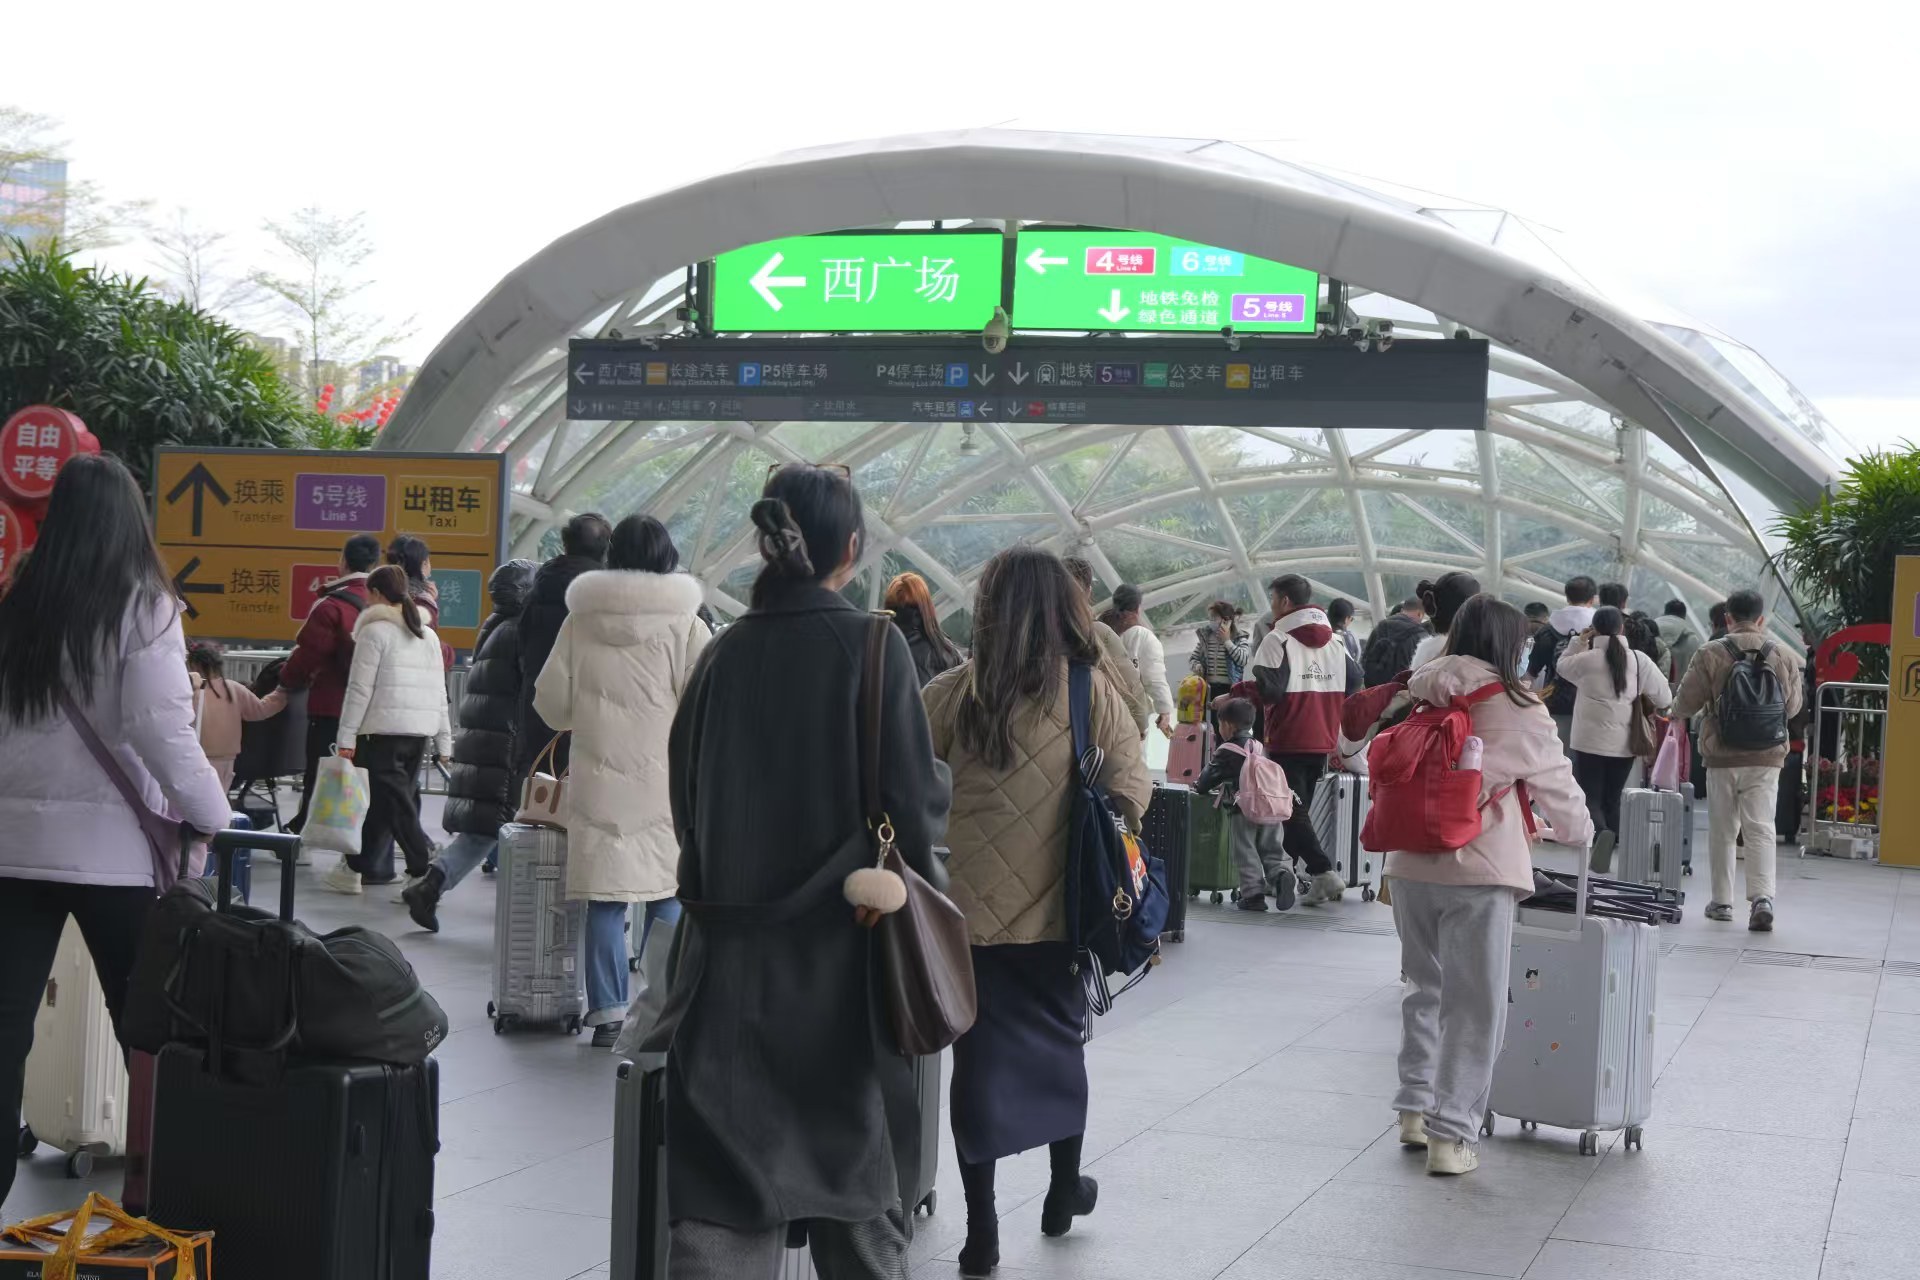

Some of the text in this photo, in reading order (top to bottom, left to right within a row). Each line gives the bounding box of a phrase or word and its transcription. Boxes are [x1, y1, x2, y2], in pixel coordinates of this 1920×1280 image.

[1095, 250, 1143, 271] 4号线
[1181, 251, 1233, 271] 6号线
[821, 257, 960, 303] 西广场
[1140, 290, 1219, 307] 地铁免检
[1242, 297, 1293, 318] 5号线
[1137, 308, 1219, 325] 绿色通道
[670, 363, 729, 378] 长途汽车
[762, 363, 828, 379] P5停车场
[876, 363, 944, 379] P4停车场
[1060, 362, 1094, 379] 地铁
[1170, 364, 1222, 381] 公交车
[1252, 364, 1304, 382] 出租车
[912, 401, 956, 412] 汽车租赁
[16, 423, 61, 448] 自由
[12, 455, 59, 481] 平等
[233, 479, 284, 505] 换乘
[312, 484, 368, 507] 5号线
[403, 485, 481, 513] 出租车
[232, 511, 284, 523] Transfer
[321, 510, 358, 522] Line 5
[427, 514, 458, 528] Taxi
[230, 568, 281, 594] 换乘
[229, 600, 281, 613] Transfer
